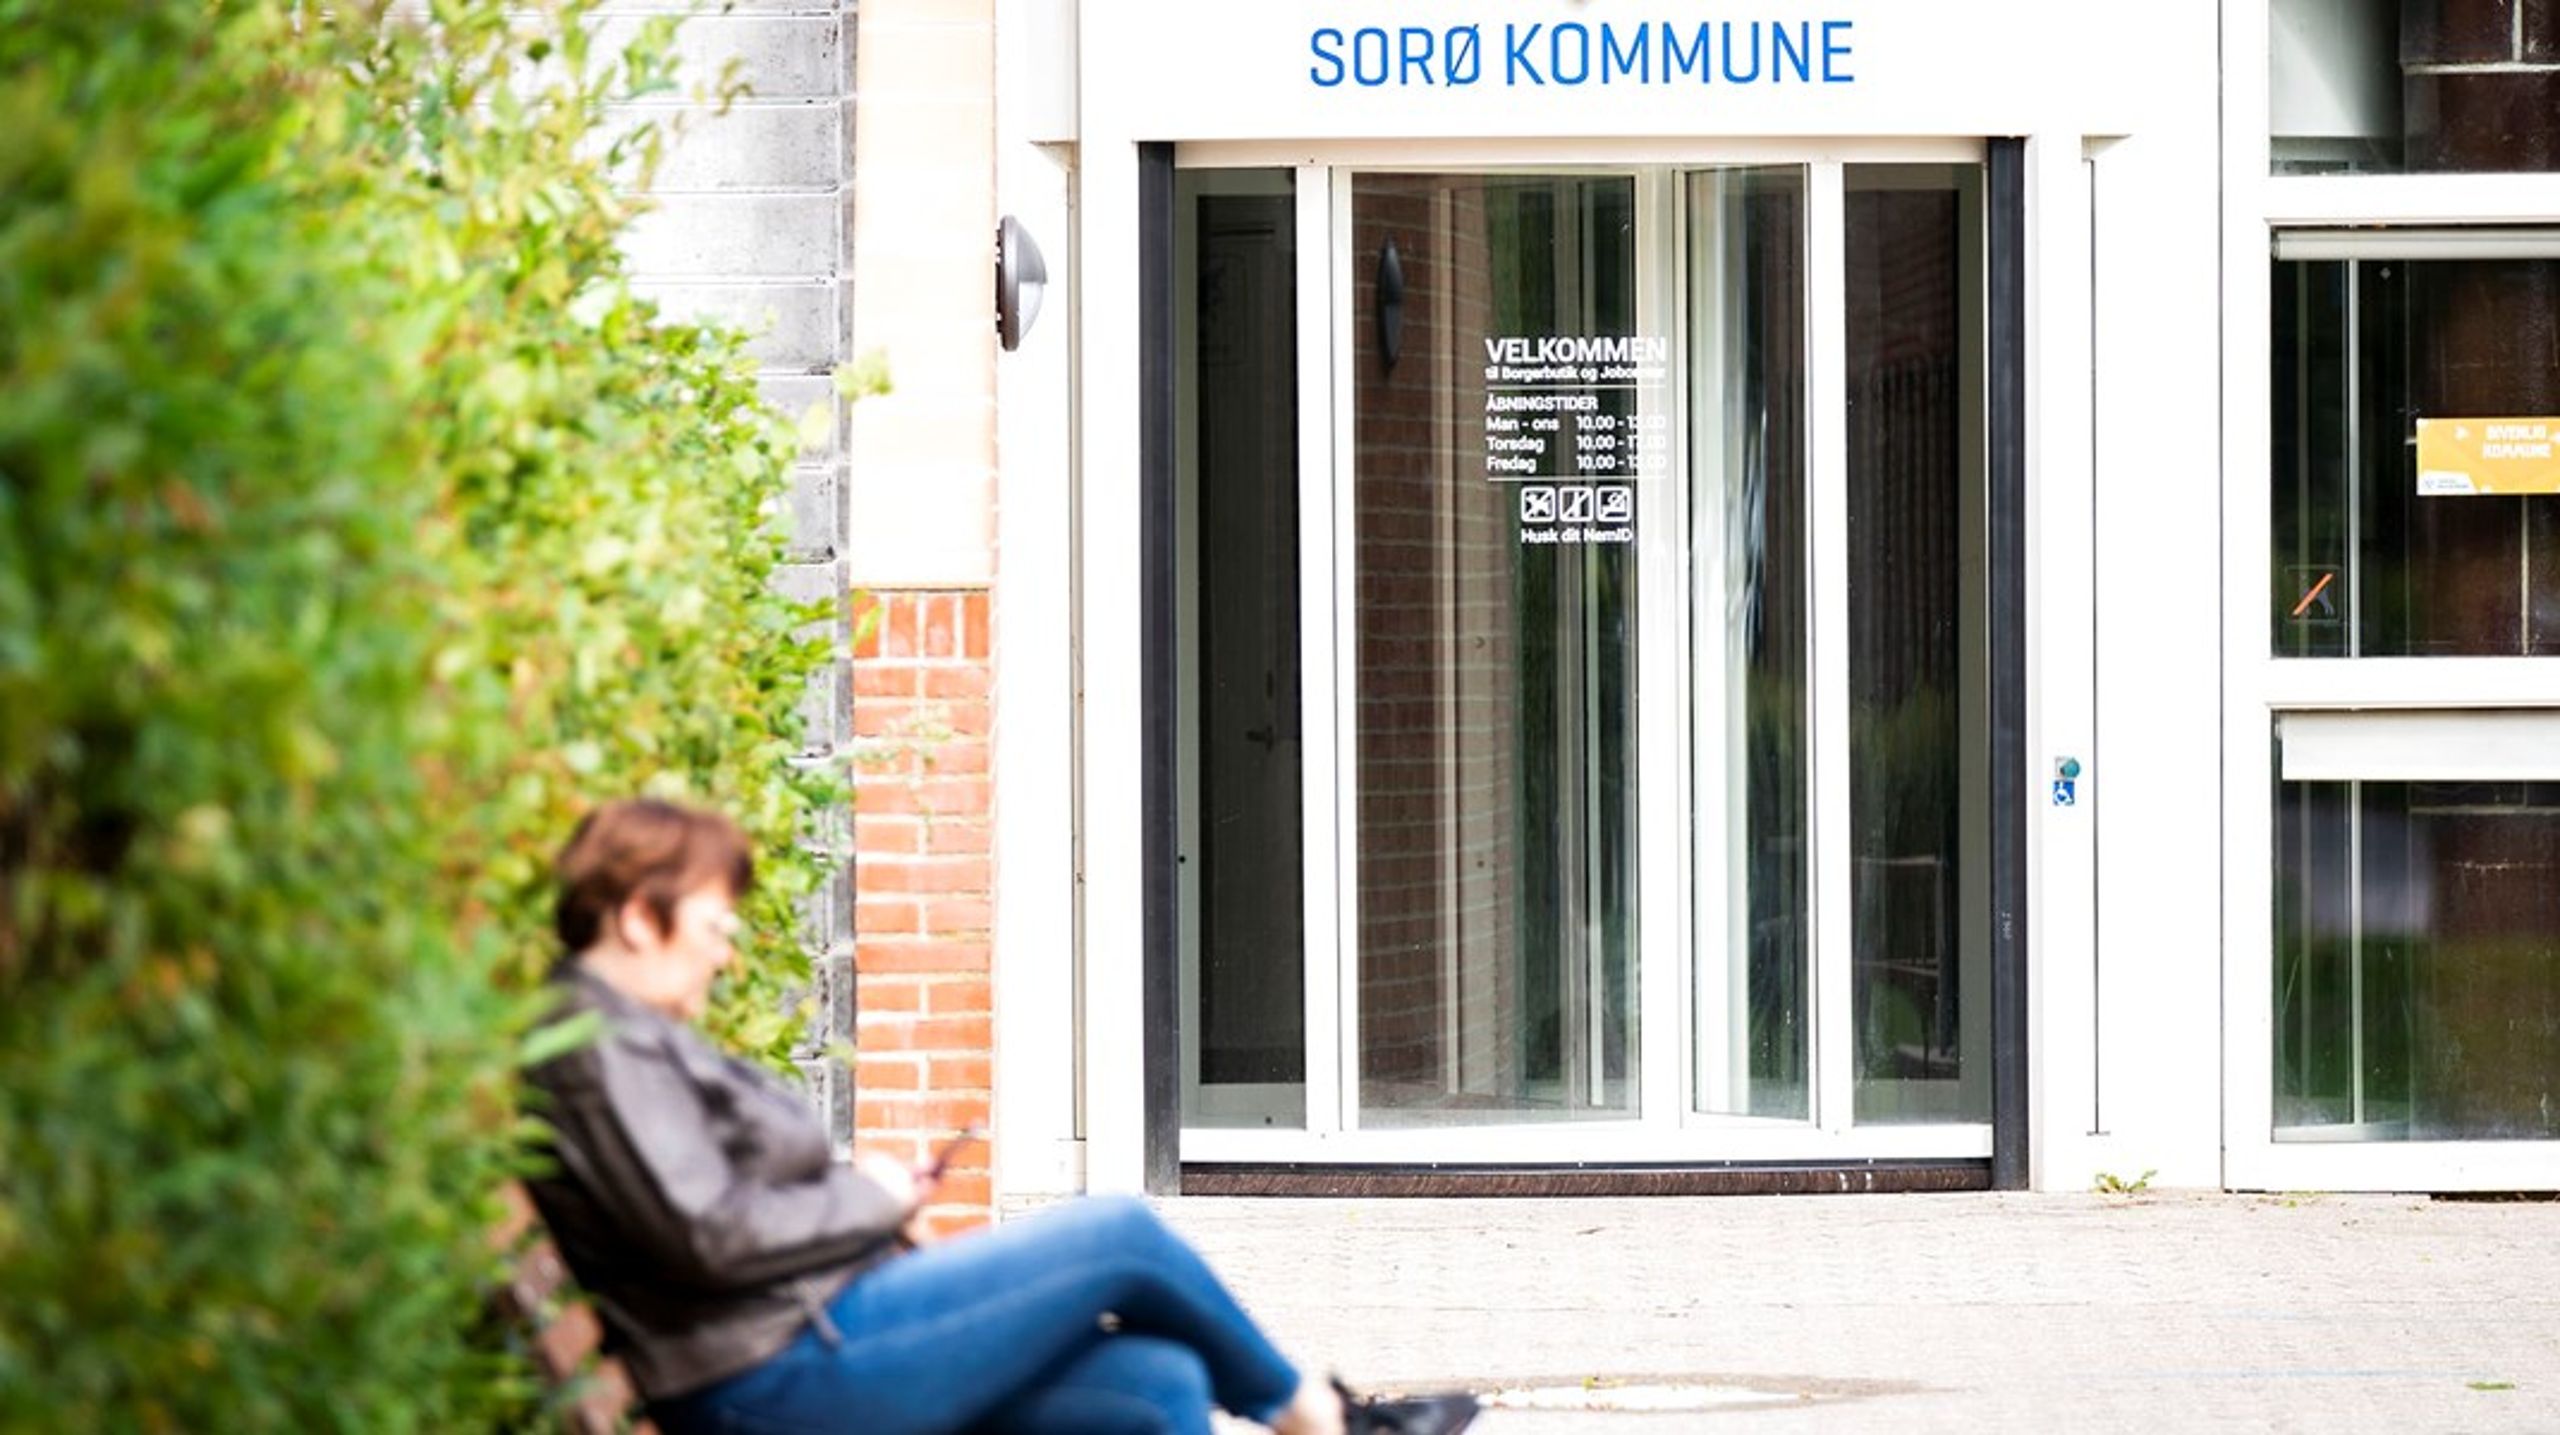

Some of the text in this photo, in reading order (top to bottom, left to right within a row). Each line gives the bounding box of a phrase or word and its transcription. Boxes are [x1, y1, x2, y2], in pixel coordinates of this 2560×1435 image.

[1309, 21, 1855, 88] SORØ KOMMUNE
[1485, 336, 1666, 362] VELKOMMEN
[1581, 368, 1597, 382] og
[1601, 365, 1665, 379] Jobcr
[1486, 394, 1598, 411] ÅBNINGSTIDER
[1486, 417, 1519, 430] Man
[1532, 420, 1559, 431] ons
[1576, 416, 1615, 430] 10.00
[1486, 436, 1544, 453] Torsdag
[1576, 435, 1615, 450] 10.00
[1487, 456, 1537, 473] Fredag
[1576, 455, 1615, 469] 10.00
[1521, 527, 1633, 543] Husk dit NemID
